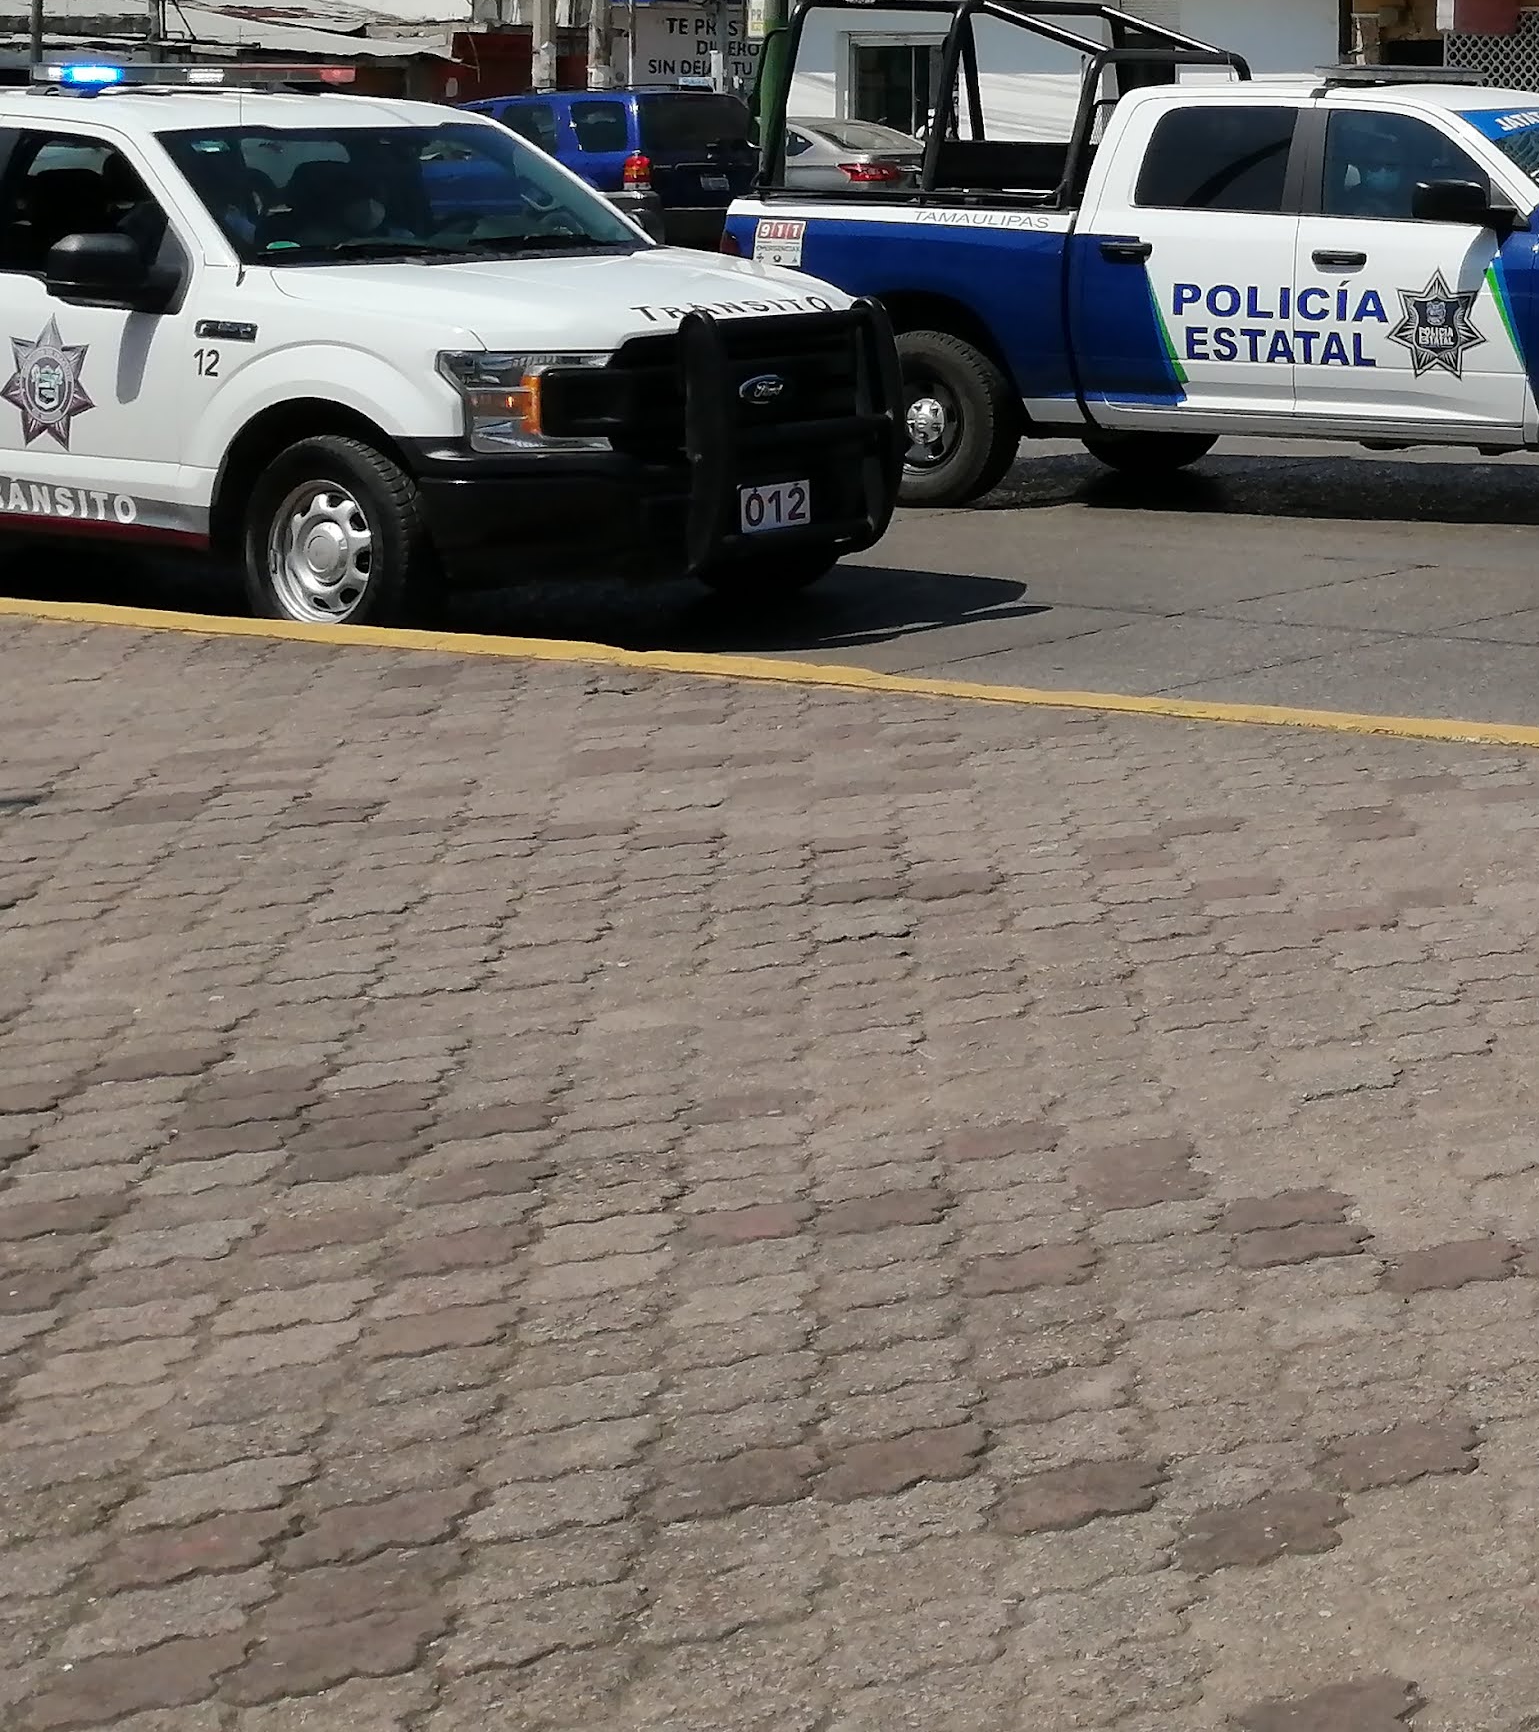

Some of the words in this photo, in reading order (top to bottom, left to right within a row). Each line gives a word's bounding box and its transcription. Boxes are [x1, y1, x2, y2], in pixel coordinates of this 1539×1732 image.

[666, 19, 688, 34] TE
[648, 60, 674, 74] SIN
[733, 62, 752, 76] TU
[914, 211, 1049, 229] TAMAULIPAS
[760, 224, 800, 239] 911
[1172, 280, 1389, 324] POLICÍA
[1184, 326, 1376, 367] ESTATAL
[193, 348, 220, 378] 12
[754, 381, 783, 398] Ford
[745, 486, 806, 527] 012
